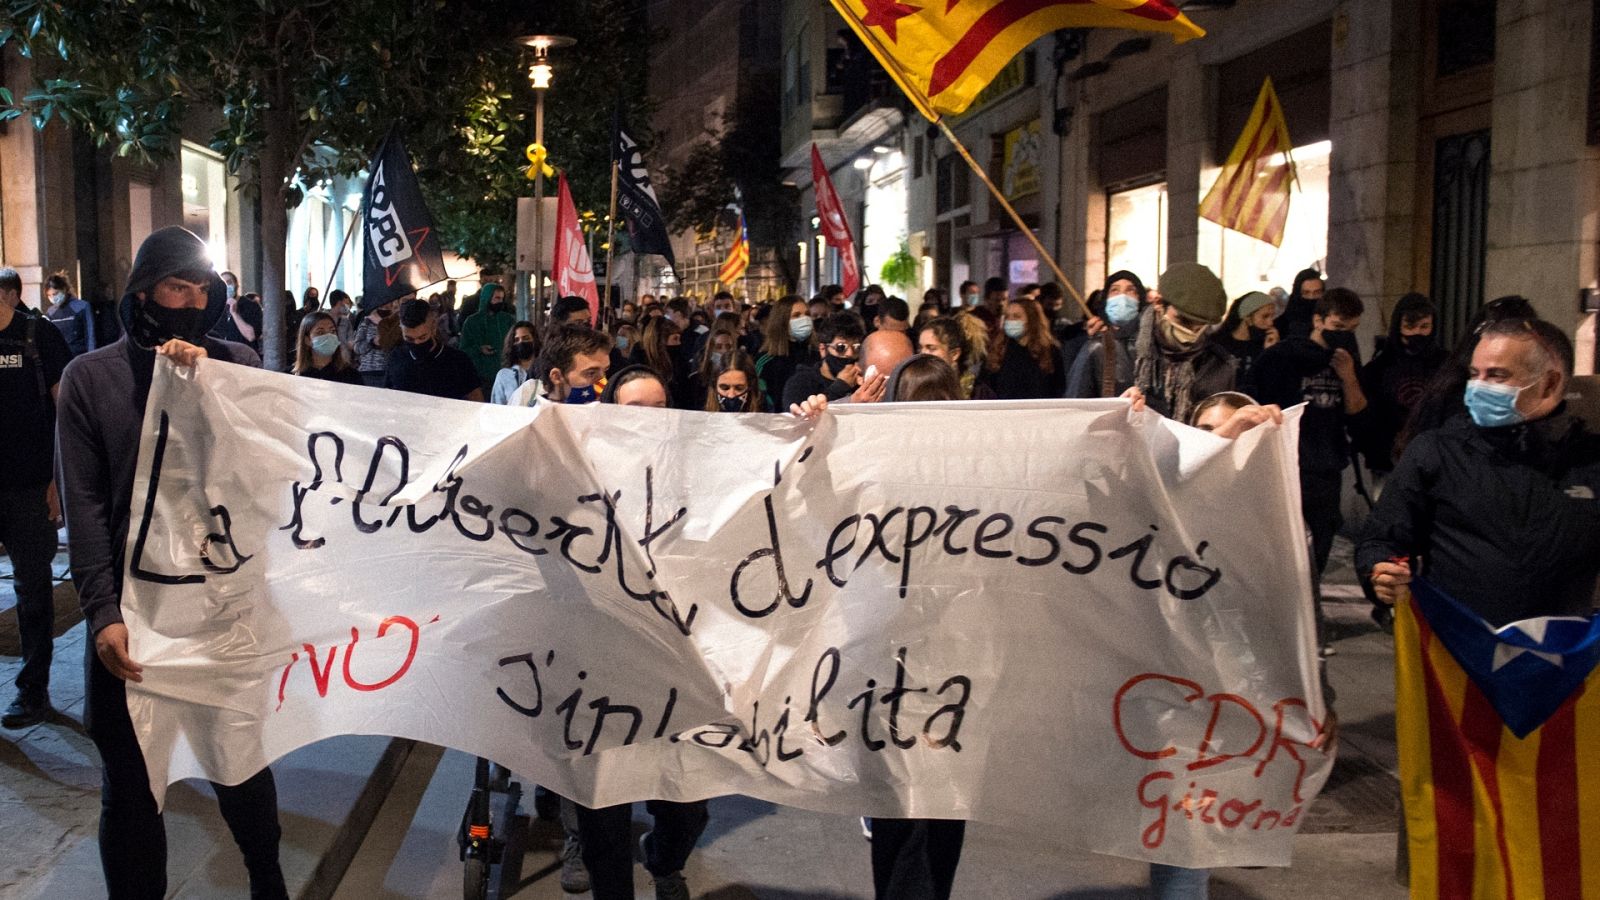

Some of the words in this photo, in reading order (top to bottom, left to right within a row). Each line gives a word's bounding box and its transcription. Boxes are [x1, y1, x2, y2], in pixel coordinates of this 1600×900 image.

[130, 409, 254, 585] La
[730, 445, 1222, 618] d'expressió
[1112, 673, 1322, 803] CDR
